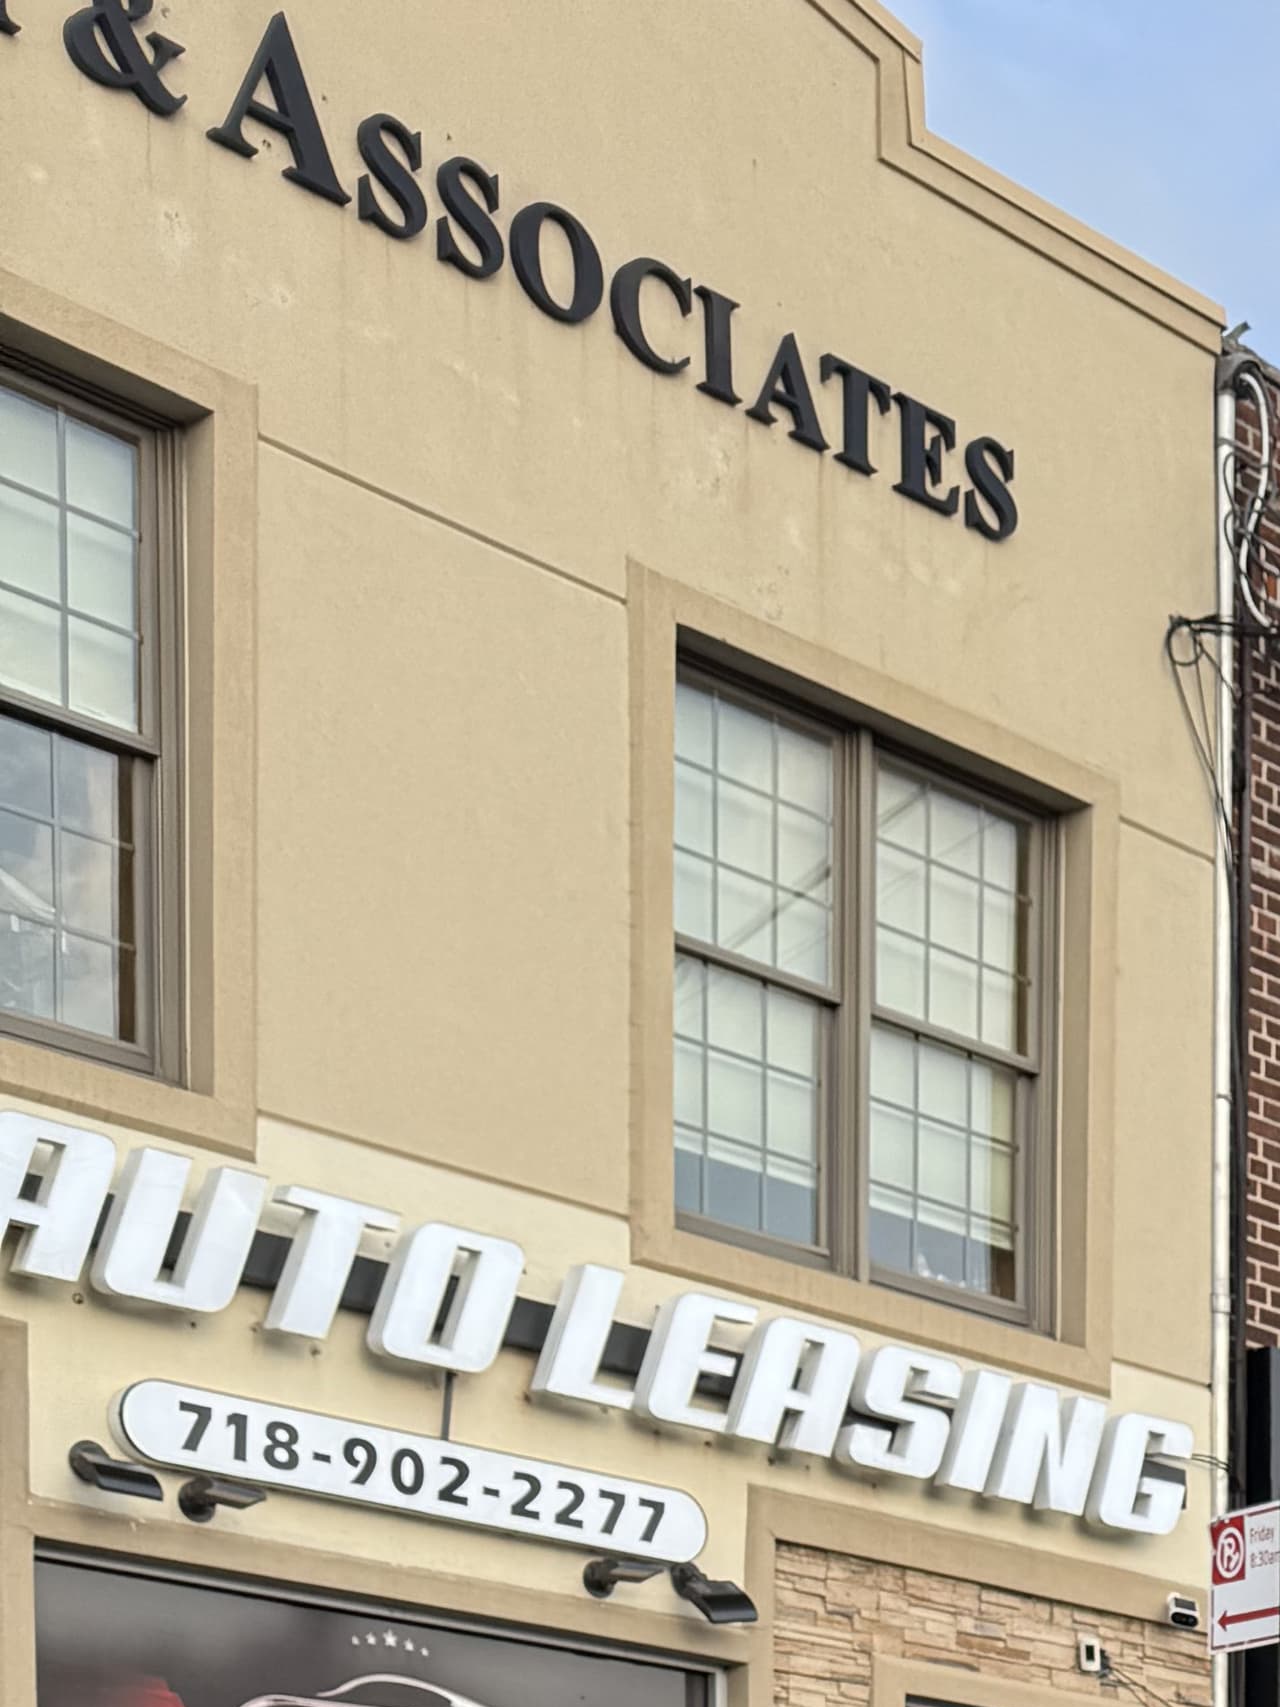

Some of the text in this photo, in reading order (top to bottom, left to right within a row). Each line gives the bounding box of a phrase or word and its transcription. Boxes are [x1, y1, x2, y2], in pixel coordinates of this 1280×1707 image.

[63, 0, 1019, 542] & ASSOCIATES
[0, 1111, 1195, 1537] AUTO LEASING
[178, 1401, 666, 1544] 718-902-2277
